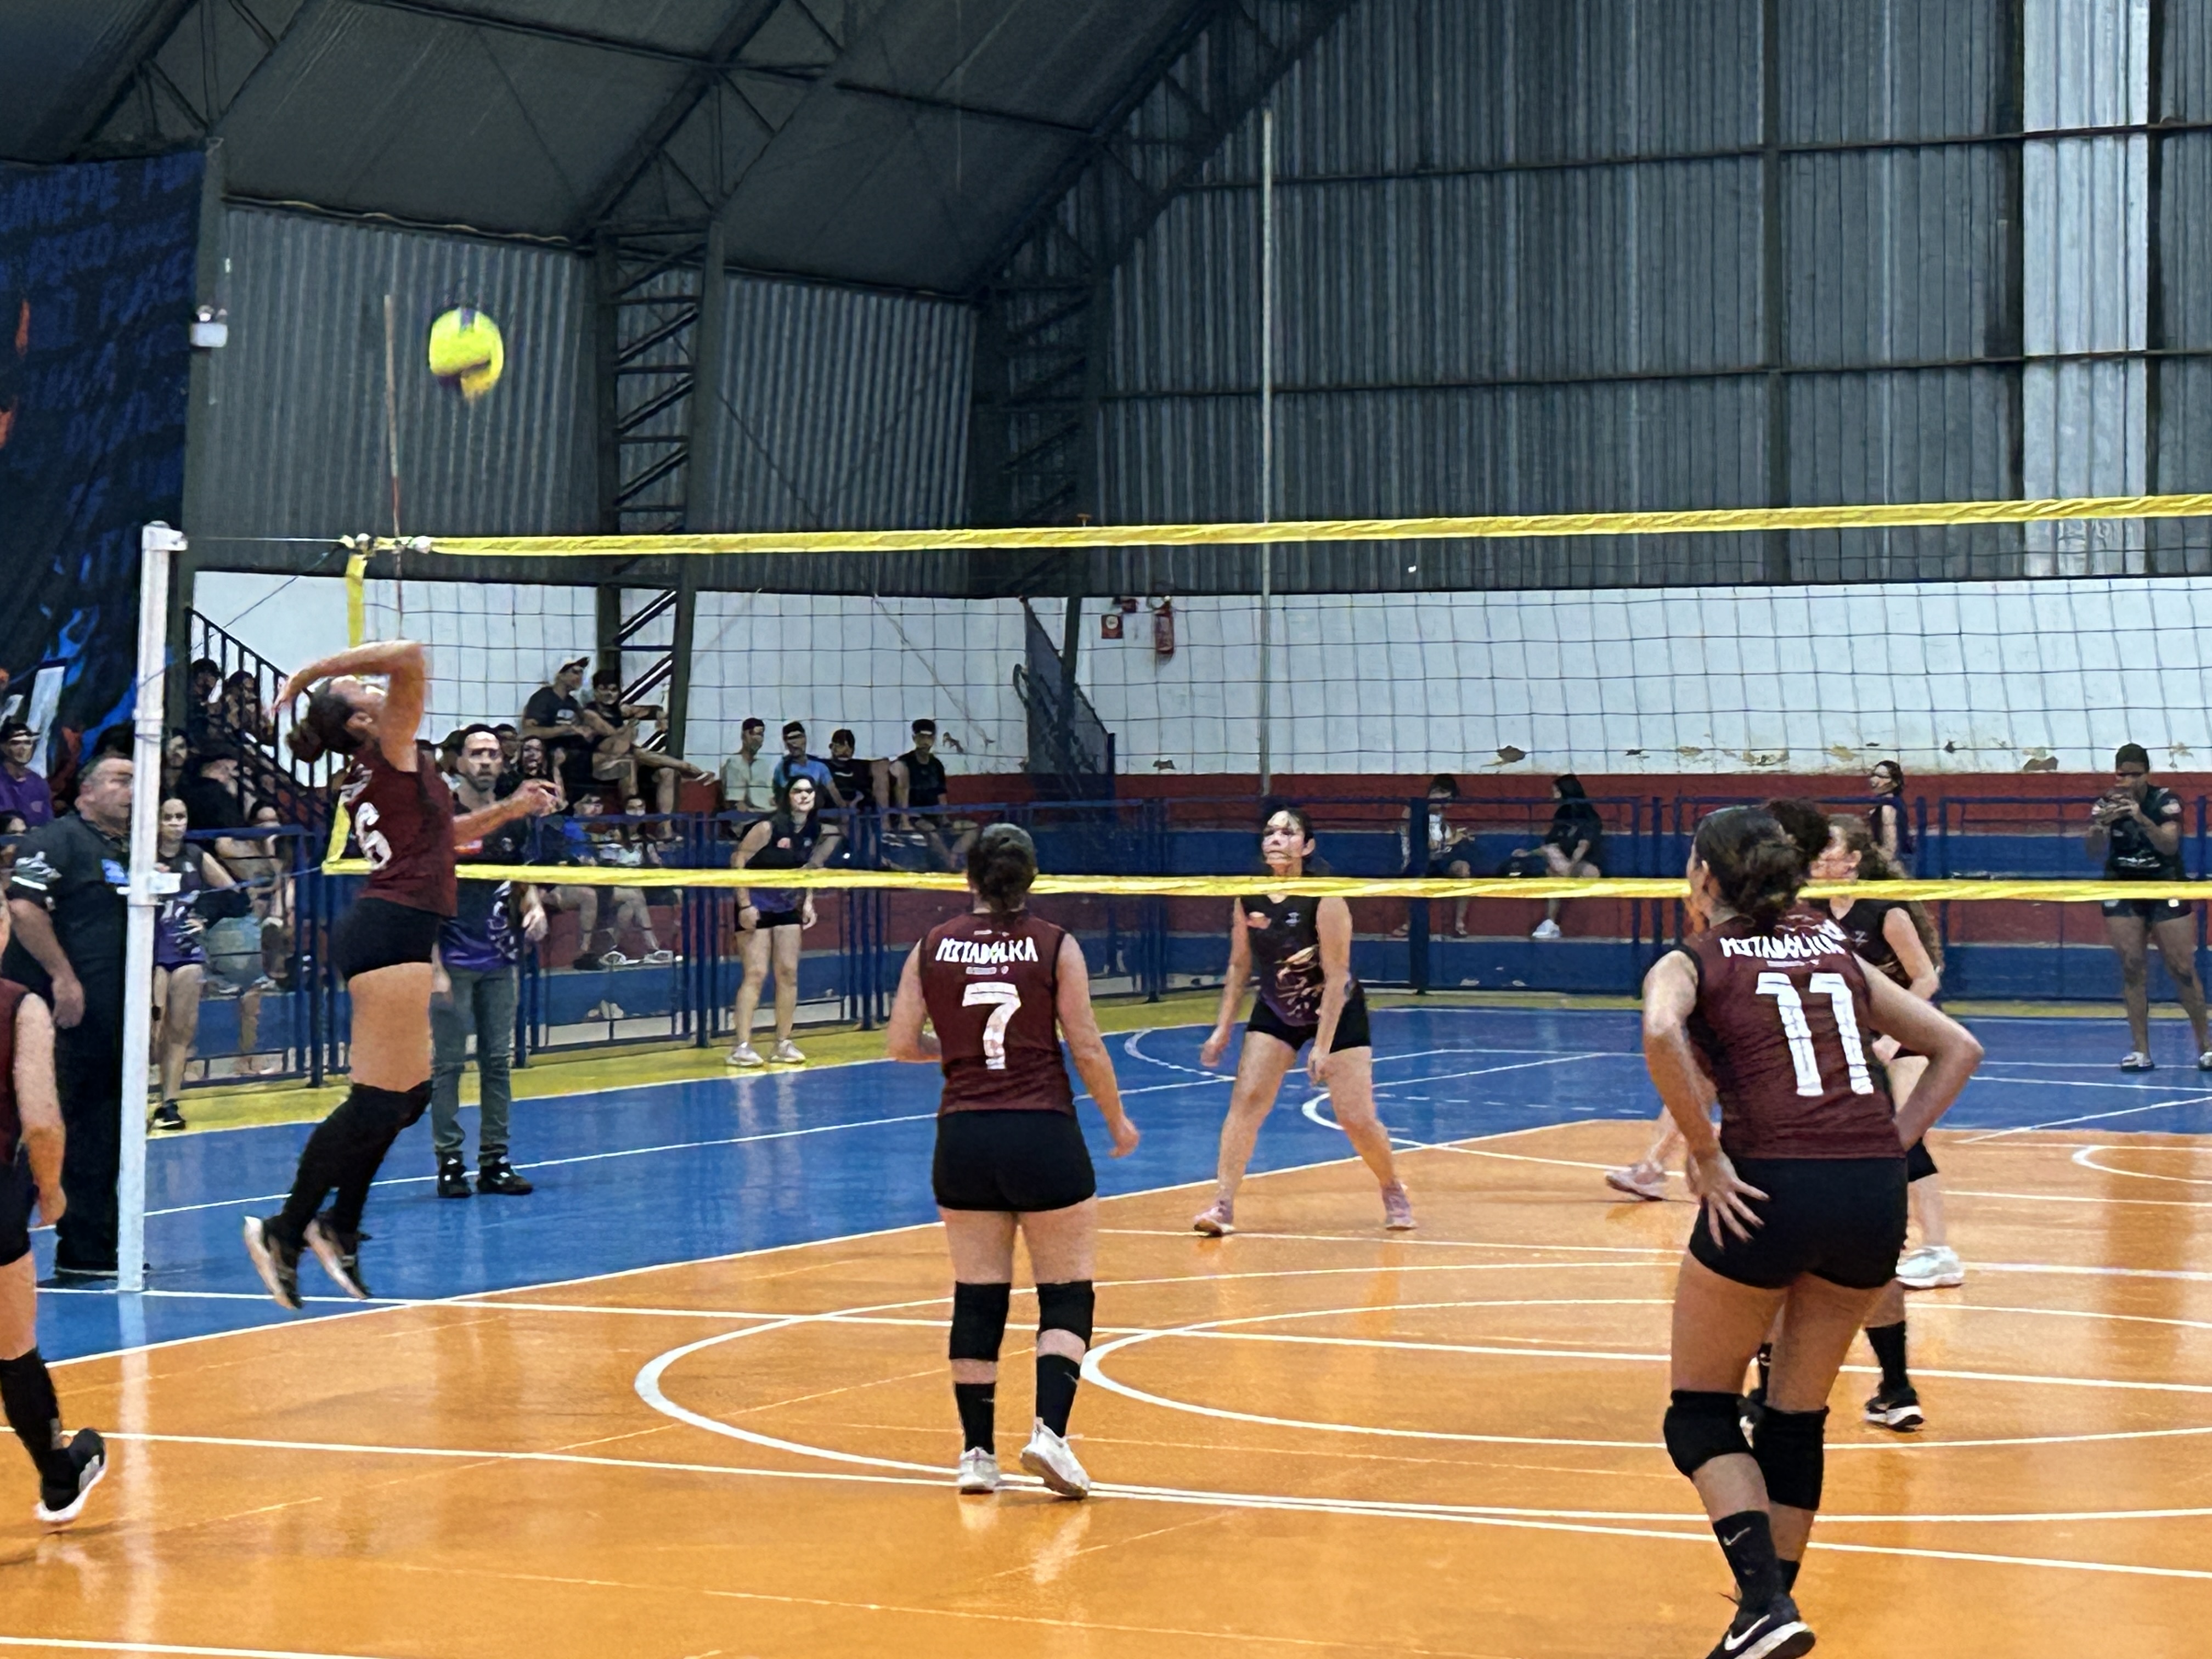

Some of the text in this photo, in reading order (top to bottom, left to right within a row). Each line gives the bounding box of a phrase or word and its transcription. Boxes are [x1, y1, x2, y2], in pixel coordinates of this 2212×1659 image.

[354, 802, 393, 871] 6
[962, 981, 1022, 1070] 7
[1756, 972, 1874, 1096] 11
